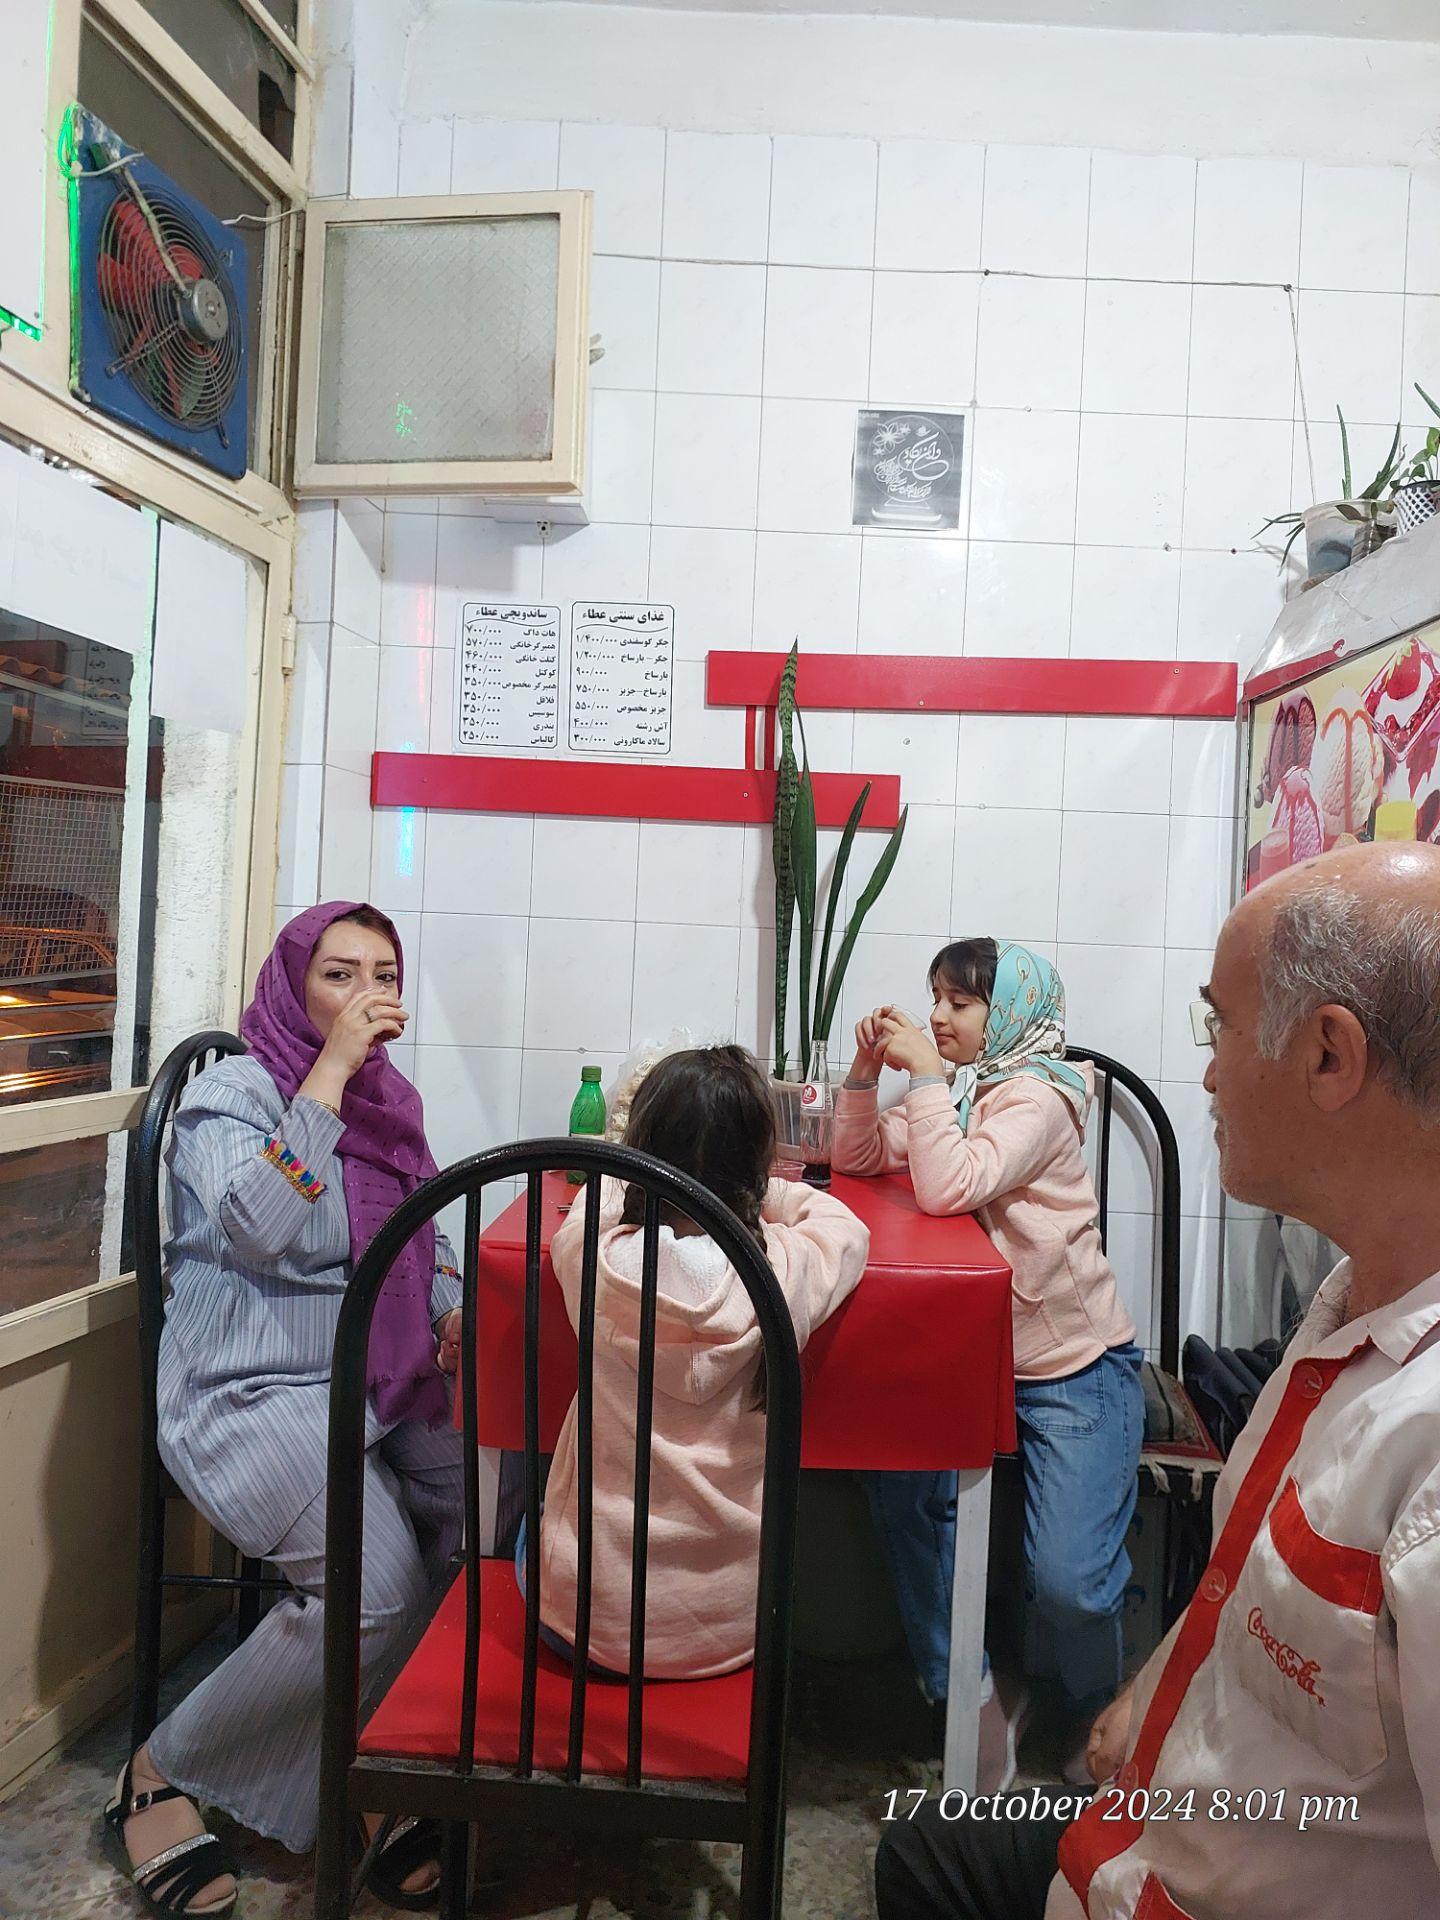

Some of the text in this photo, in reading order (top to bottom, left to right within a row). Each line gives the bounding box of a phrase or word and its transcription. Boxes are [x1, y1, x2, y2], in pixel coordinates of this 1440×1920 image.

[476, 607, 547, 620] ساندویچی عطاء
[583, 609, 664, 624] غذای سنتی عطاء
[465, 624, 501, 635] ۷۰۰/۰۰۰
[466, 638, 502, 647] ۵۷۰/۰۰۰
[465, 651, 502, 661] ۴۶۰/۰۰۰
[465, 664, 556, 678] کوکتل ۴۴۰/۰۰۰
[576, 667, 607, 676] ۹۰۰/۰۰۰
[464, 677, 501, 686] ۳۵۰/۰۰۰
[502, 681, 531, 689] مخصوص
[576, 684, 609, 693] ۷۵۰/۰۰۰
[464, 692, 554, 705] فلافل ۳۵۰/۰۰۰
[464, 704, 500, 714] ۳۵۰/۰۰۰
[575, 701, 608, 710] ۵۵۰/۰۰۰
[617, 704, 647, 713] مخصوص
[463, 717, 554, 732] بندری ۳۵۰/۰۰۰
[574, 718, 668, 732] آش رشته ۴۰۰/۰۰۰
[530, 736, 554, 744] کالباس
[614, 736, 645, 746] ماکارونی
